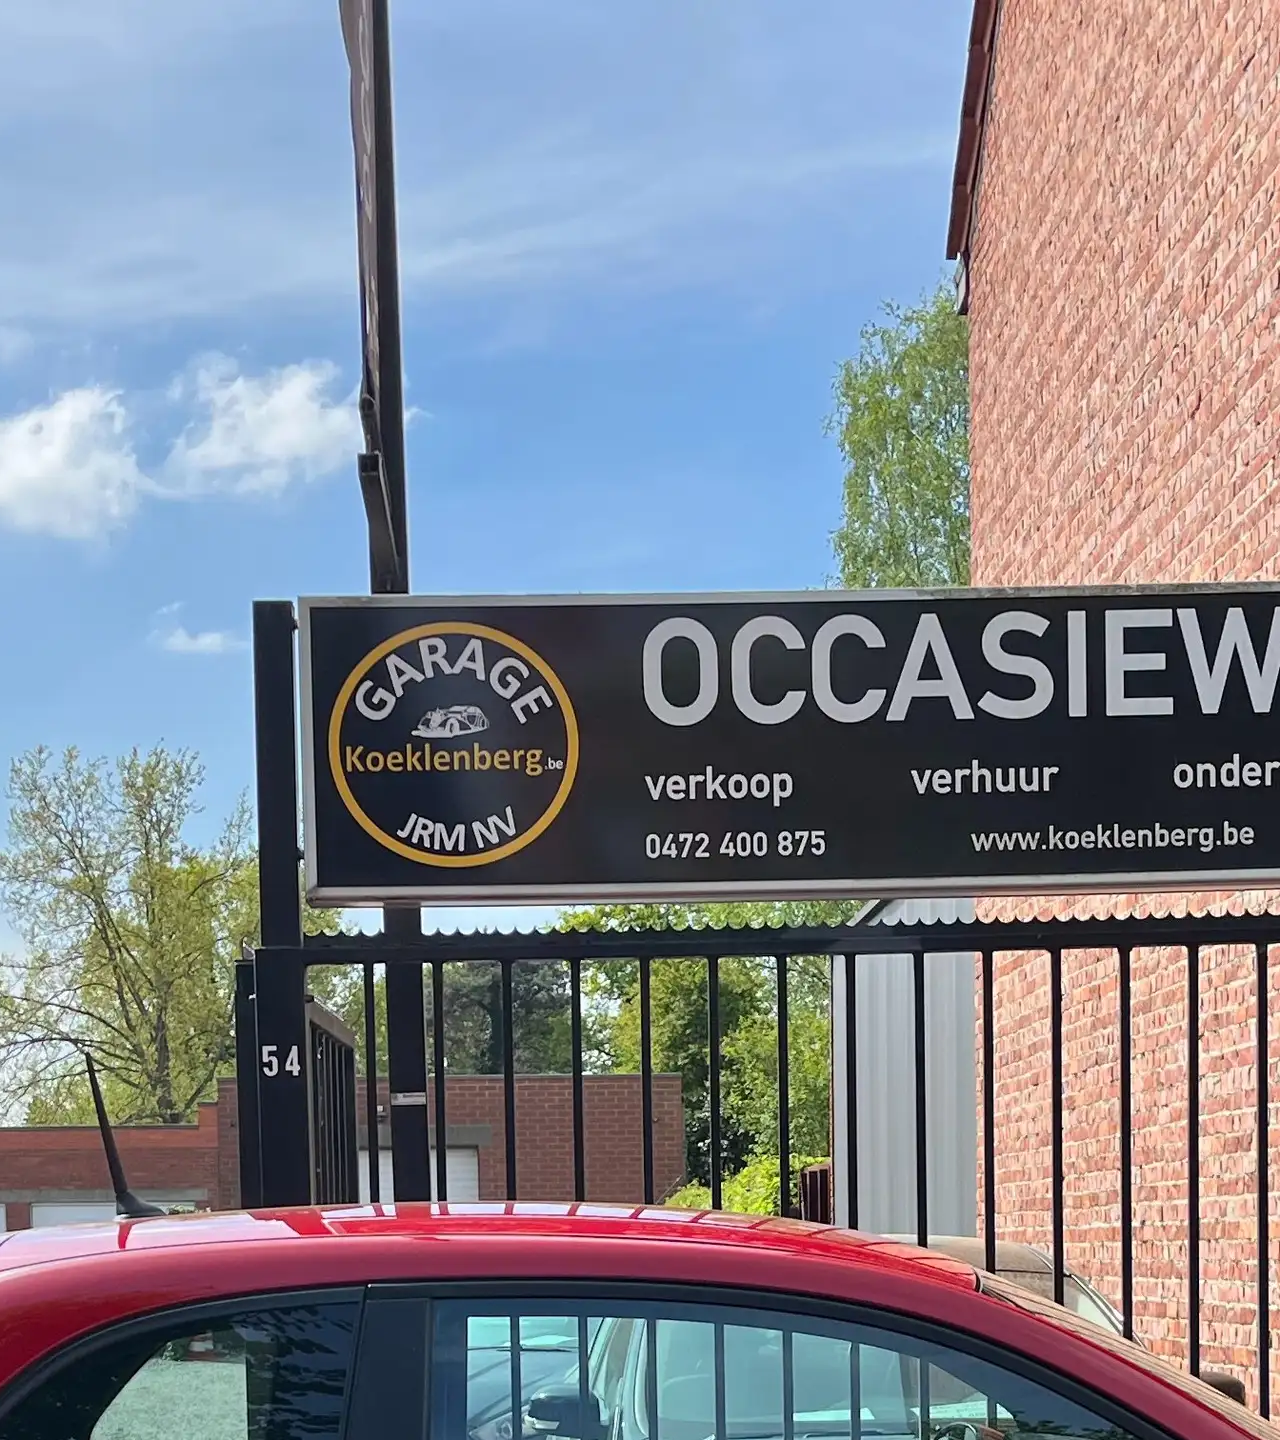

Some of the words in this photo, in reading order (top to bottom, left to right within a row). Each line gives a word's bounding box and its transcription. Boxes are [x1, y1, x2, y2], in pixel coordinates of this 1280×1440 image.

[354, 636, 554, 725] GARAGE
[345, 742, 565, 776] Koeklenberg.be
[644, 765, 793, 807] verkoop
[910, 759, 1060, 794] verhuur
[396, 812, 466, 852] JRM
[471, 805, 517, 849] NV
[644, 832, 710, 859] 0472
[719, 831, 768, 857] 400
[777, 830, 826, 857] 875
[969, 820, 1255, 853] www.koeklenberg.be
[261, 1045, 301, 1077] 54
